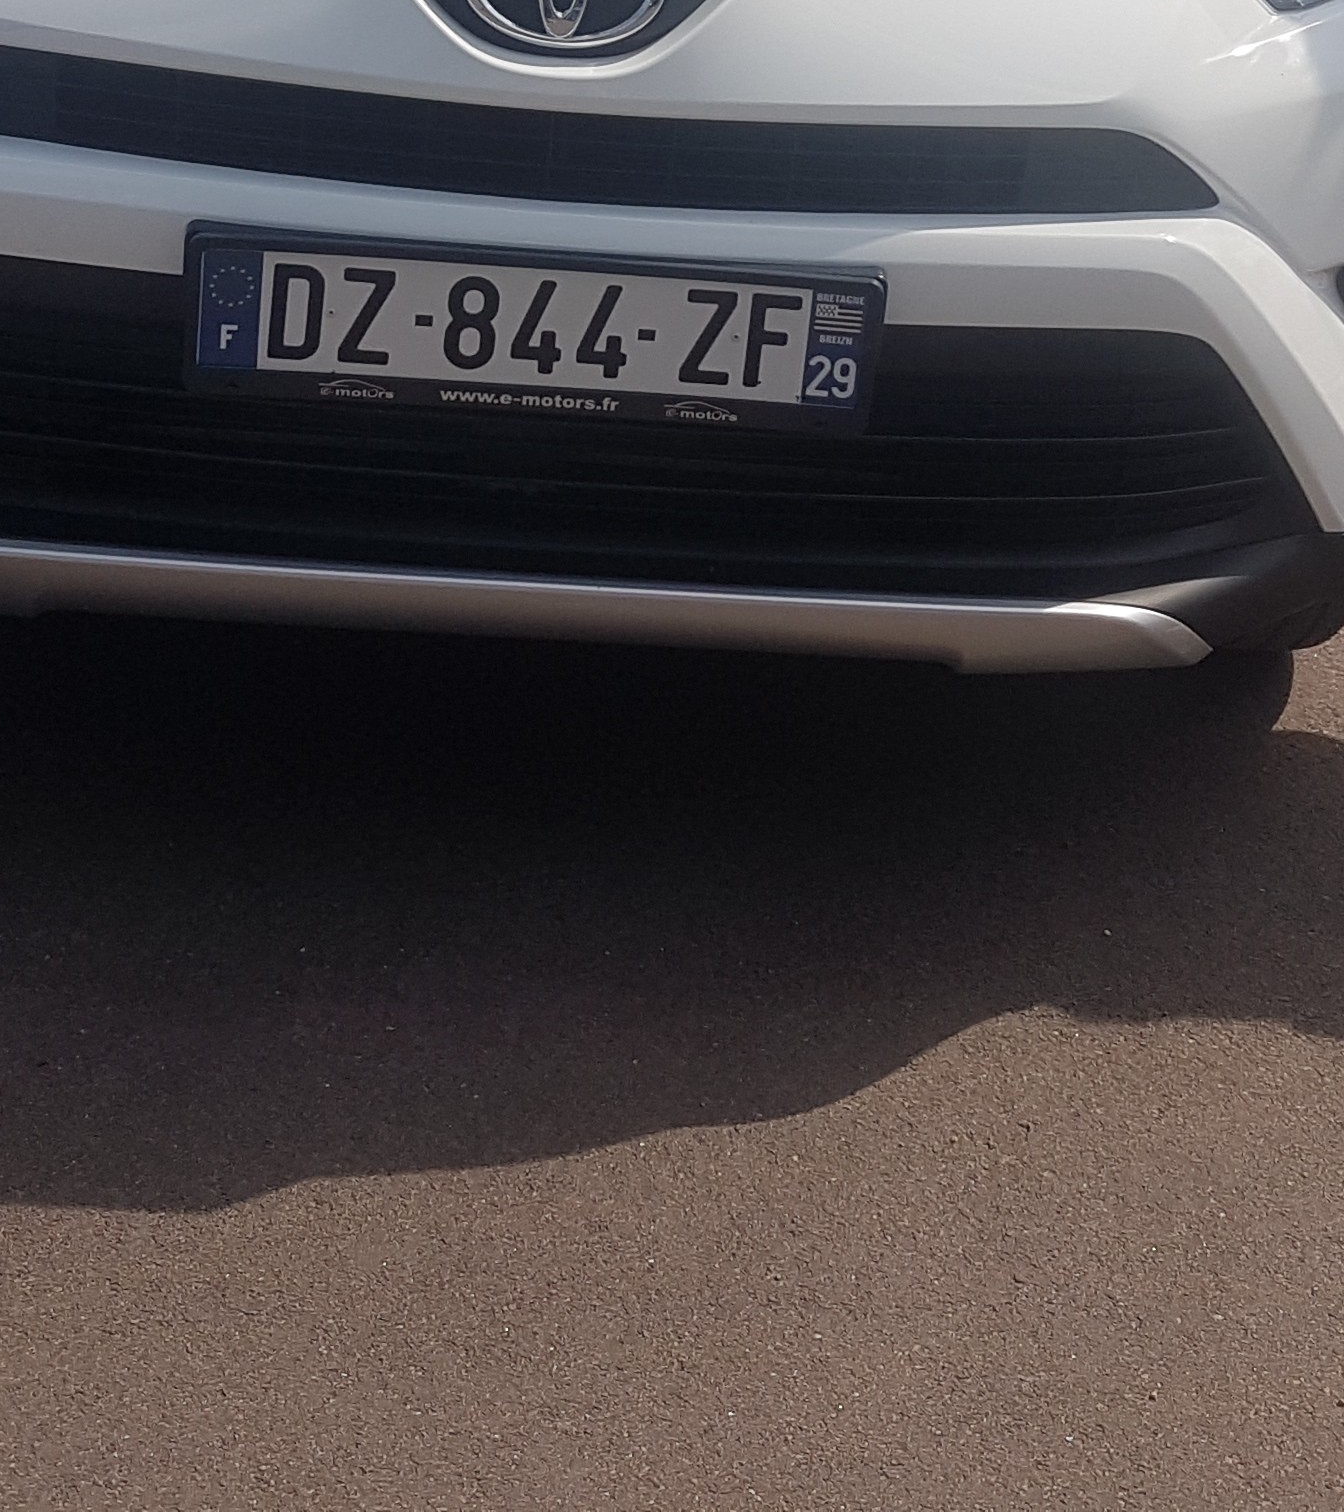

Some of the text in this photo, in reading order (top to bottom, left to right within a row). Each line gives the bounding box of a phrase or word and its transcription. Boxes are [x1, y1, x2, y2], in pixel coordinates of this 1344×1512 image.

[219, 323, 238, 350] F
[266, 262, 804, 388] DZ-844-ZF
[805, 354, 857, 399] 29
[440, 389, 620, 412] www.e-motors.fr
